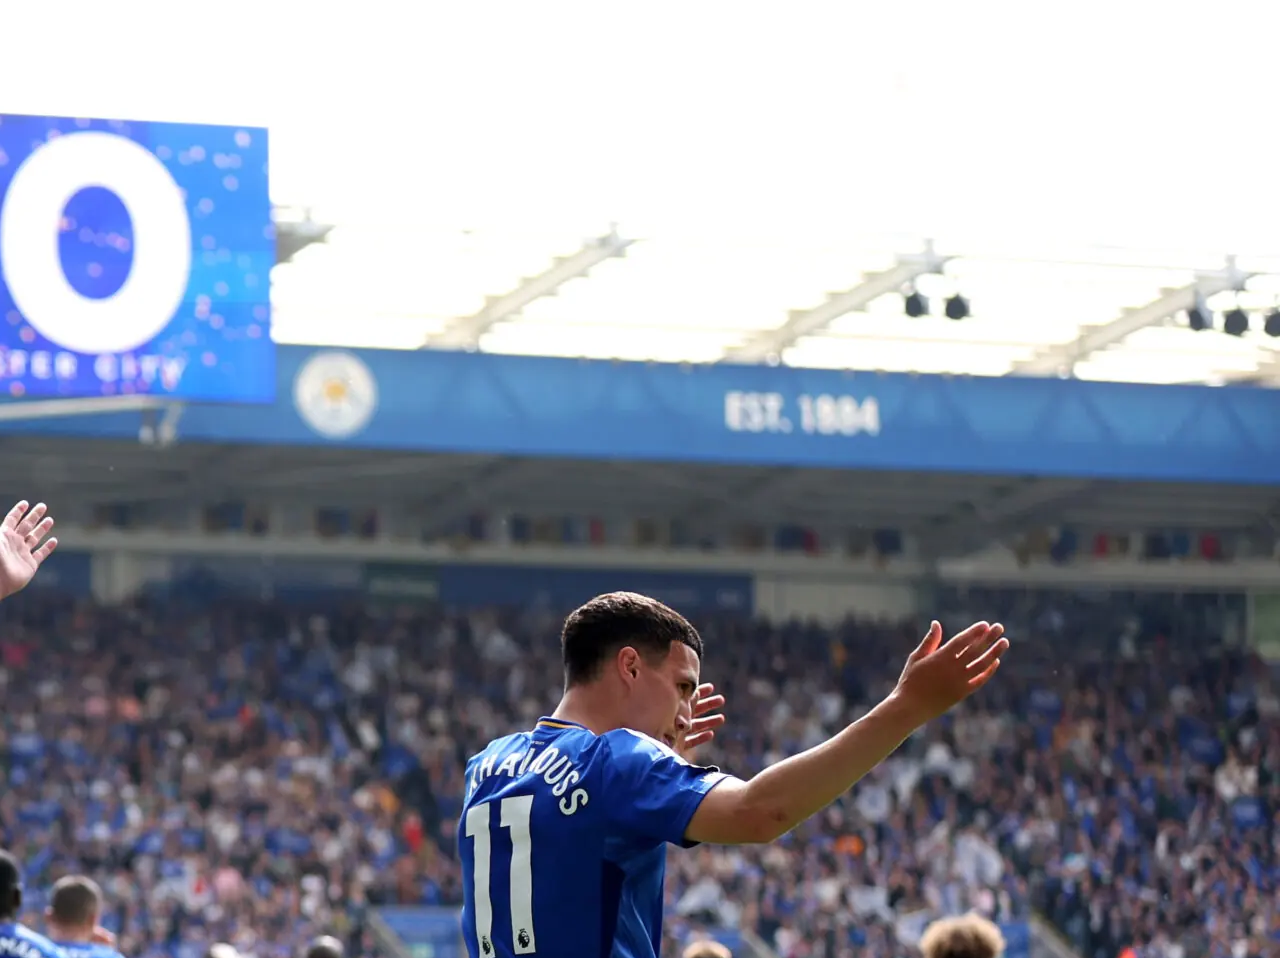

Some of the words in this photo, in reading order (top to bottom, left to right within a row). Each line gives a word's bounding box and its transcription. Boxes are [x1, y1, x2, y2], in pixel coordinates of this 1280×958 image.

[94, 350, 186, 388] CITY
[725, 391, 793, 433] EST.
[798, 394, 880, 436] 1884
